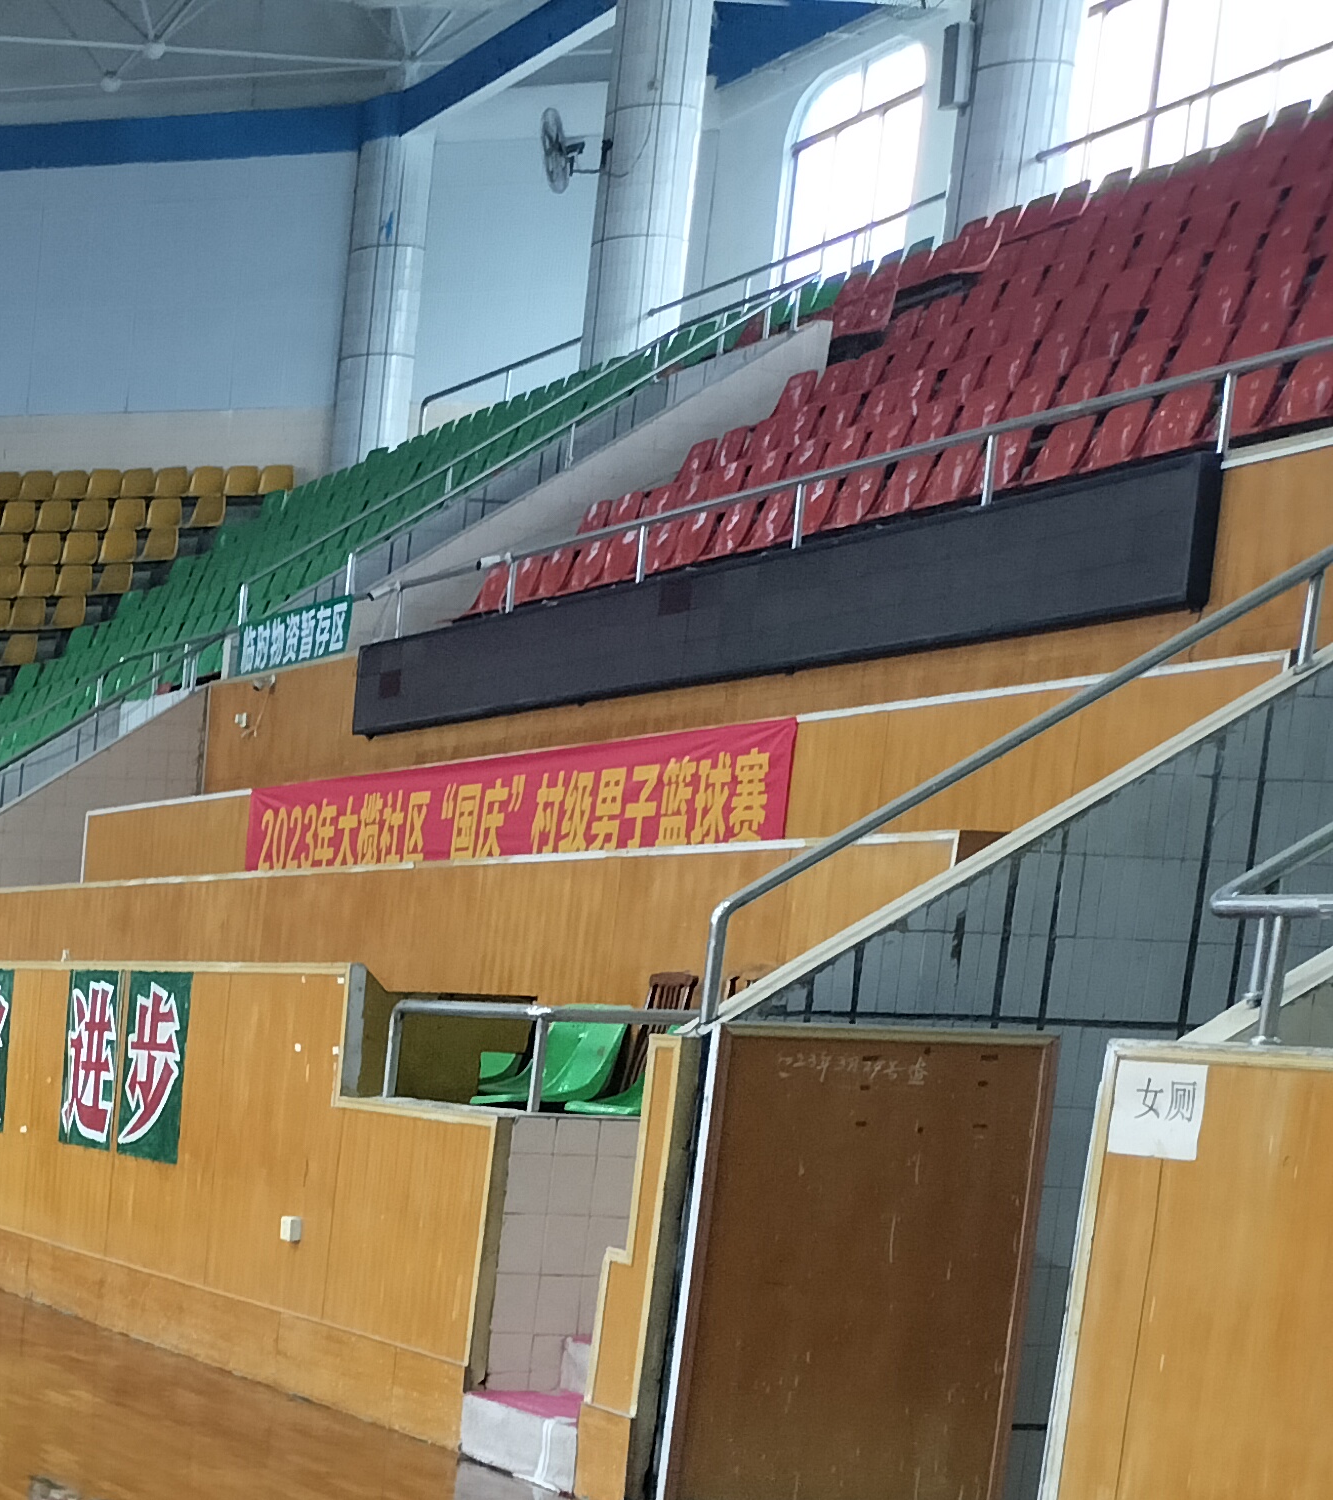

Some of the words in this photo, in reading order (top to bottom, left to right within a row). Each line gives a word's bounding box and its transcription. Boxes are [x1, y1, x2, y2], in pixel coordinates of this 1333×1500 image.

[240, 601, 348, 674] 临时物资暂存区
[61, 980, 181, 1144] 进步
[1134, 1077, 1197, 1123] 女厕
